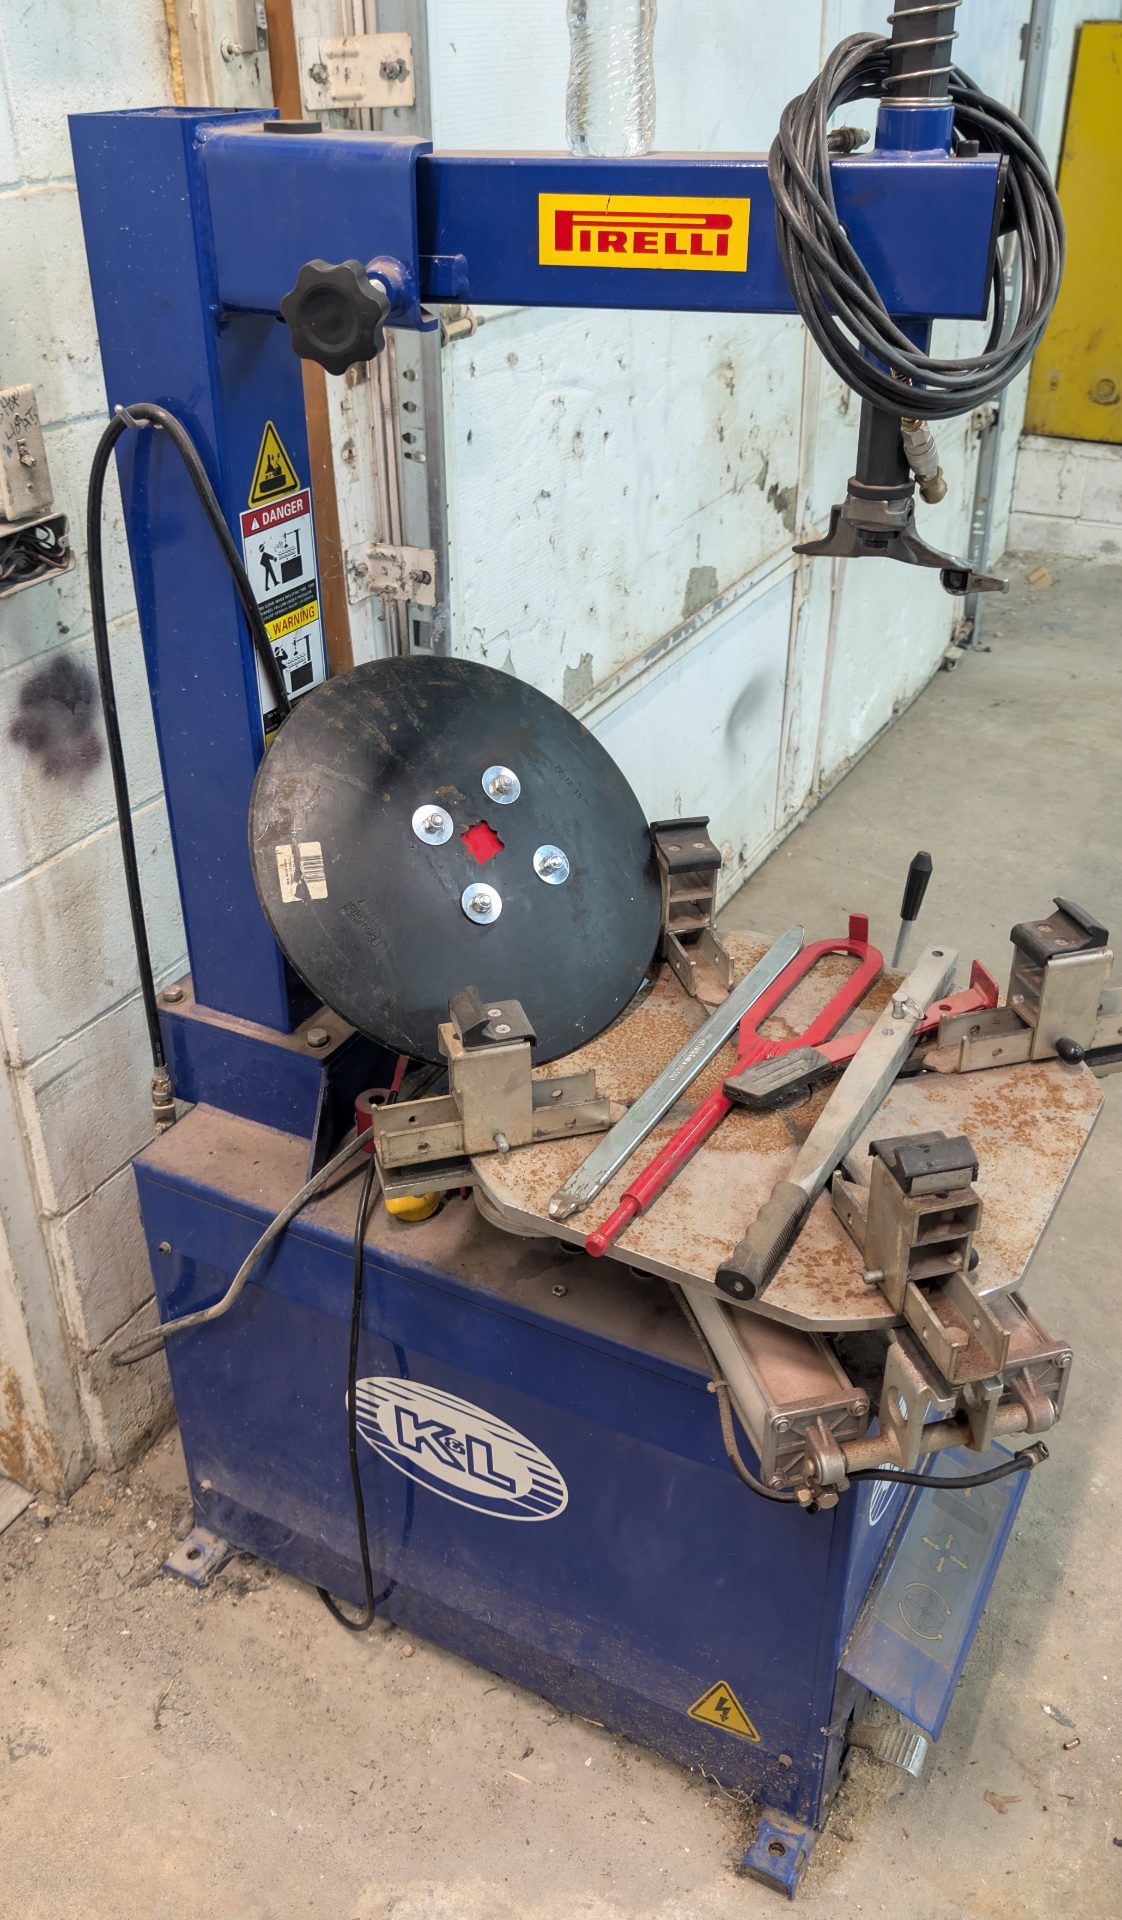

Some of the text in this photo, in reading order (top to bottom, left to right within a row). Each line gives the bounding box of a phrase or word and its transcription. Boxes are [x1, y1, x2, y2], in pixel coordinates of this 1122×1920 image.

[555, 210, 733, 256] PIRELLI
[262, 498, 304, 526] DANGER
[272, 605, 315, 635] WARNING
[394, 1404, 517, 1495] K&L
